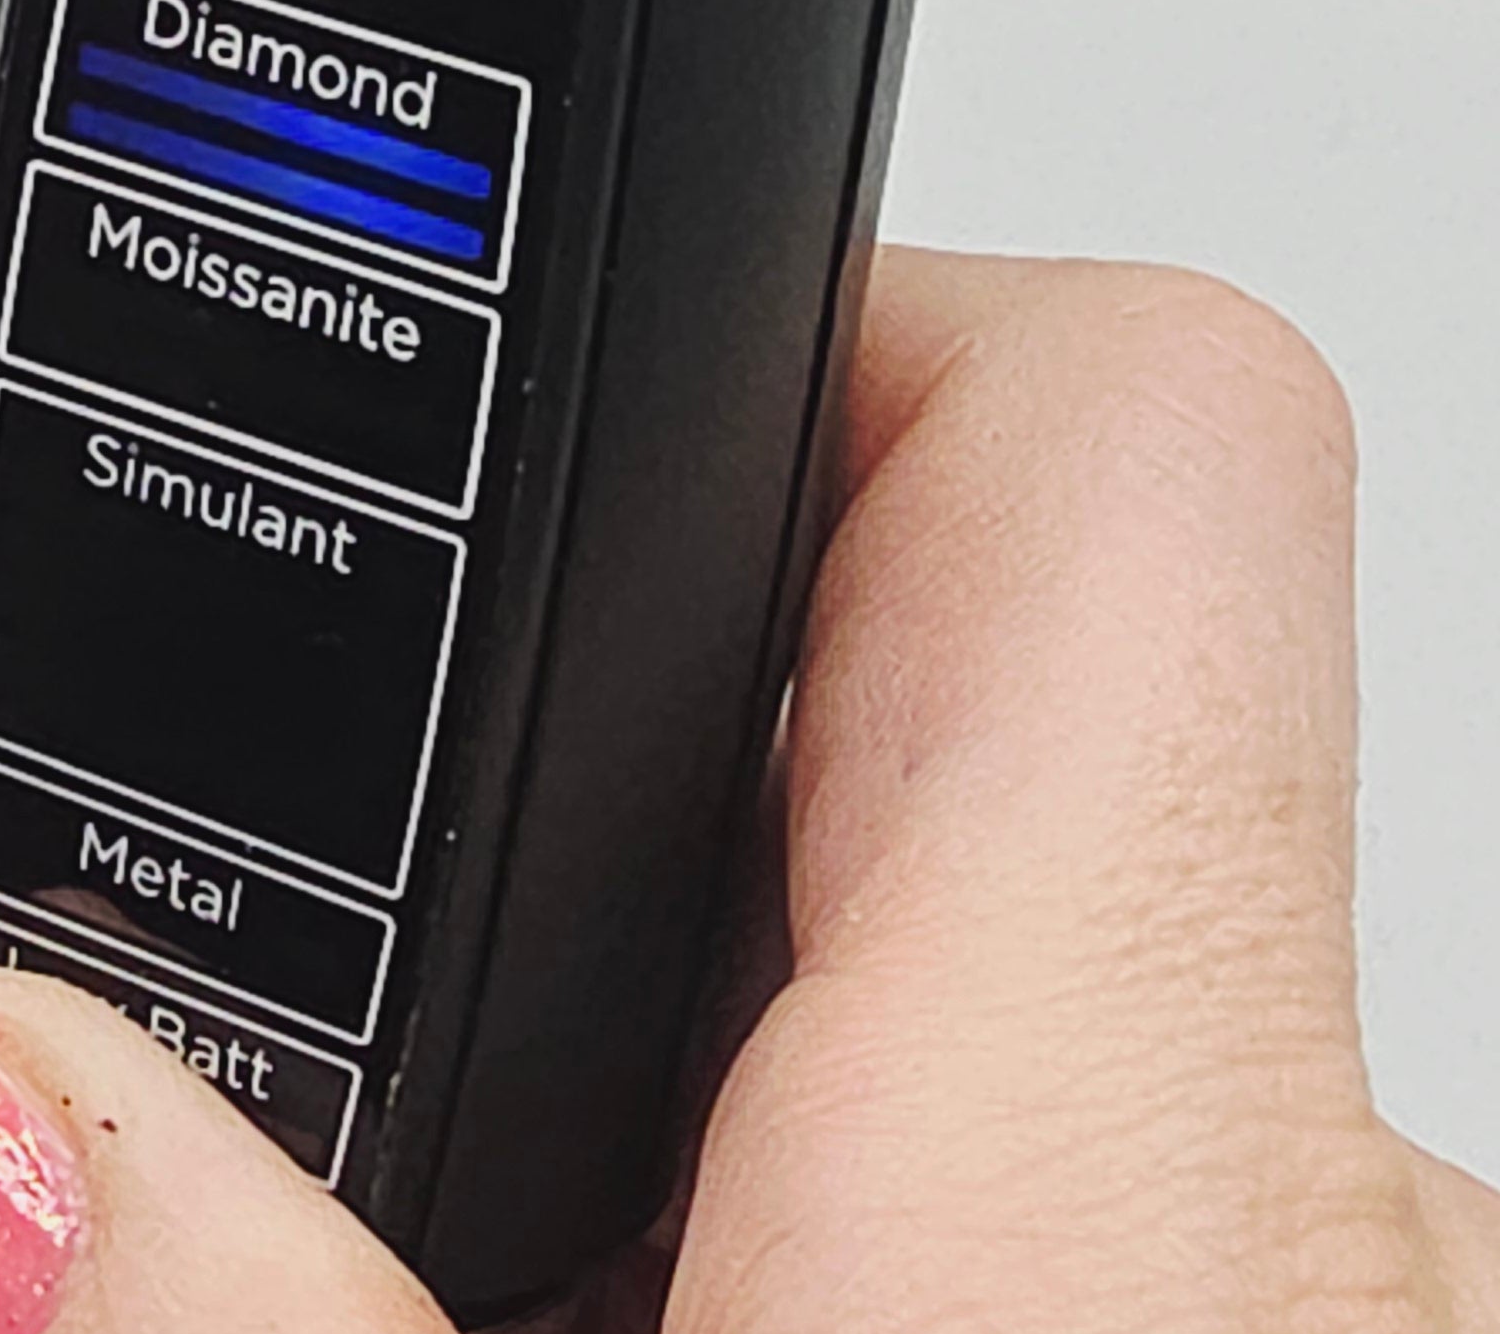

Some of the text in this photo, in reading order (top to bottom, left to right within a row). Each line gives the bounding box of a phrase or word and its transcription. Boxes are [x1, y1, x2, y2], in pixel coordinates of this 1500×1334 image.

[87, 203, 422, 362] Moissanite
[82, 433, 358, 575] Simulant
[79, 822, 243, 931] Metal
[149, 1004, 275, 1101] Batt
